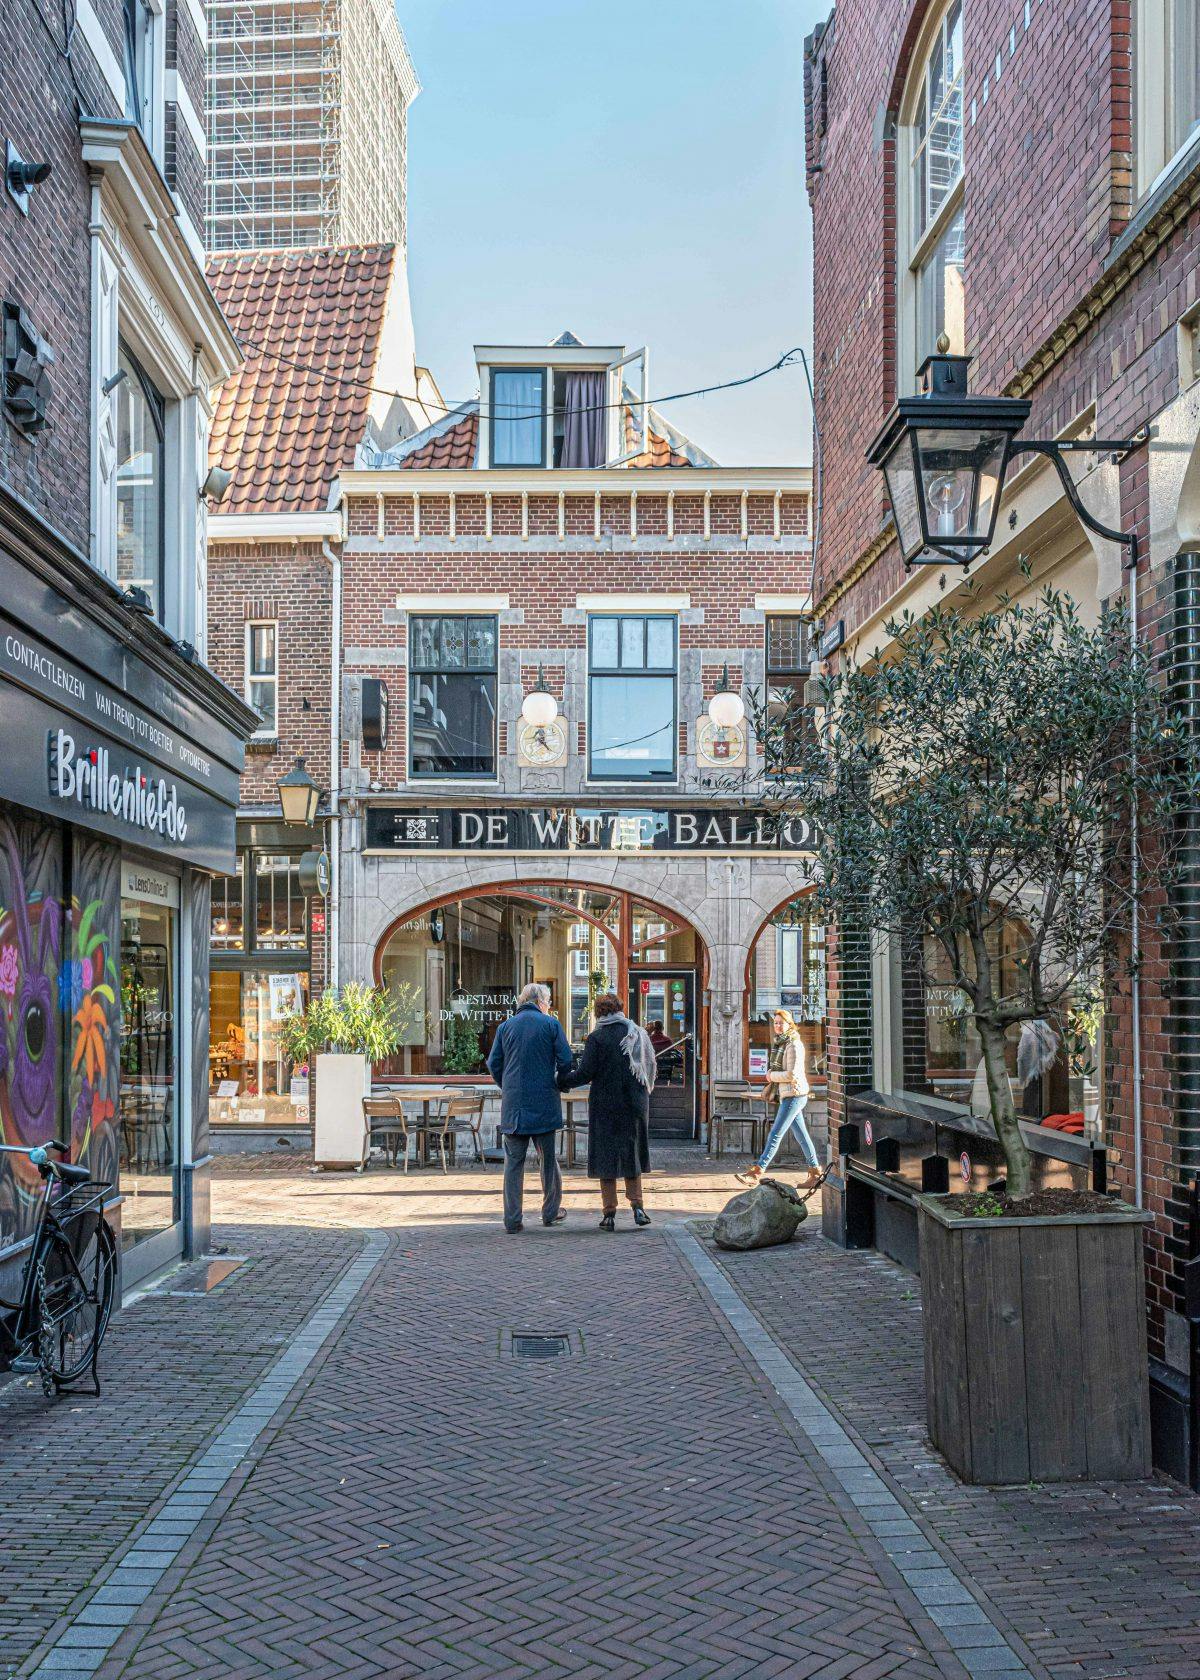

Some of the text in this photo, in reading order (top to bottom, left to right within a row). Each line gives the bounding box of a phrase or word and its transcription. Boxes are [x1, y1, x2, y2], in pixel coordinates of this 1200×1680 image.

[6, 635, 85, 701] CONTACTLENZEN
[95, 691, 173, 754] VAN TREND TOT BOETIEK
[57, 728, 188, 842] Brillenliefde
[458, 813, 509, 844] DE
[530, 813, 655, 844] WITTE
[439, 1009, 456, 1021] DE
[460, 1010, 502, 1021] WITTE
[458, 994, 519, 1005] RESTAURA
